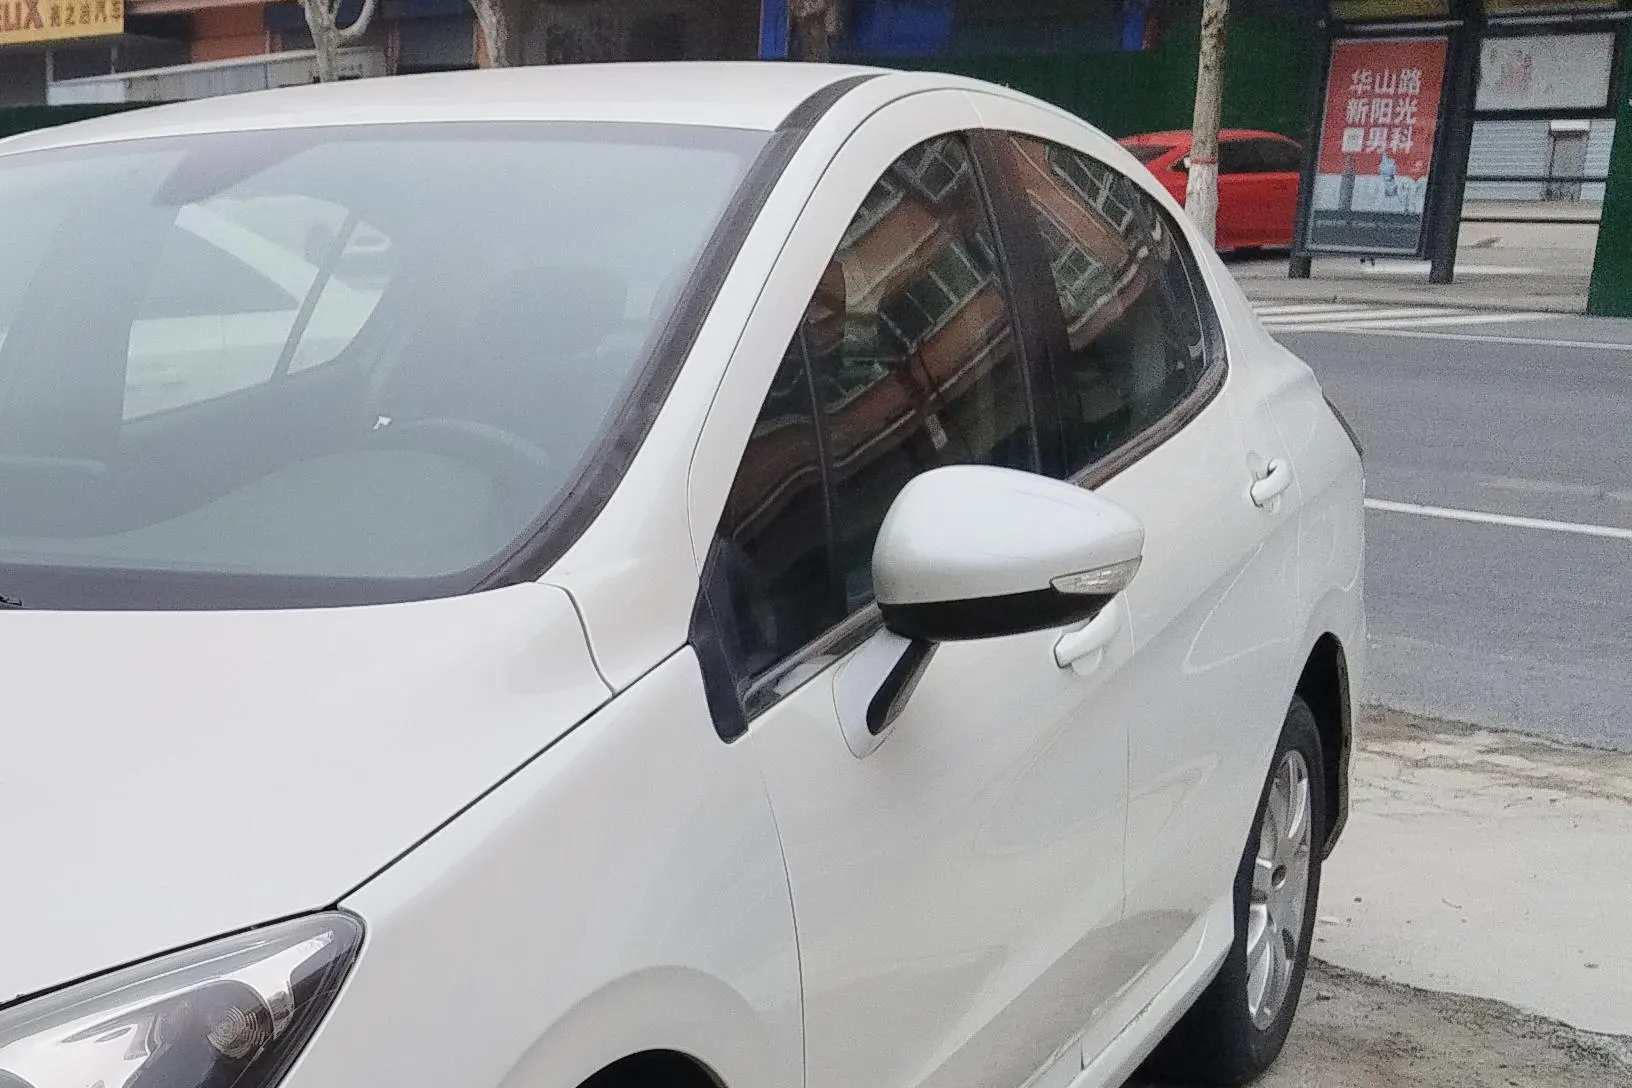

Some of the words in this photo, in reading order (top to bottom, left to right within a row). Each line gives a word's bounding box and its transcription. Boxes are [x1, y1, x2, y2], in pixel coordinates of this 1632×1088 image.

[1349, 68, 1422, 95] 华山路
[1346, 97, 1418, 125] 新阳光
